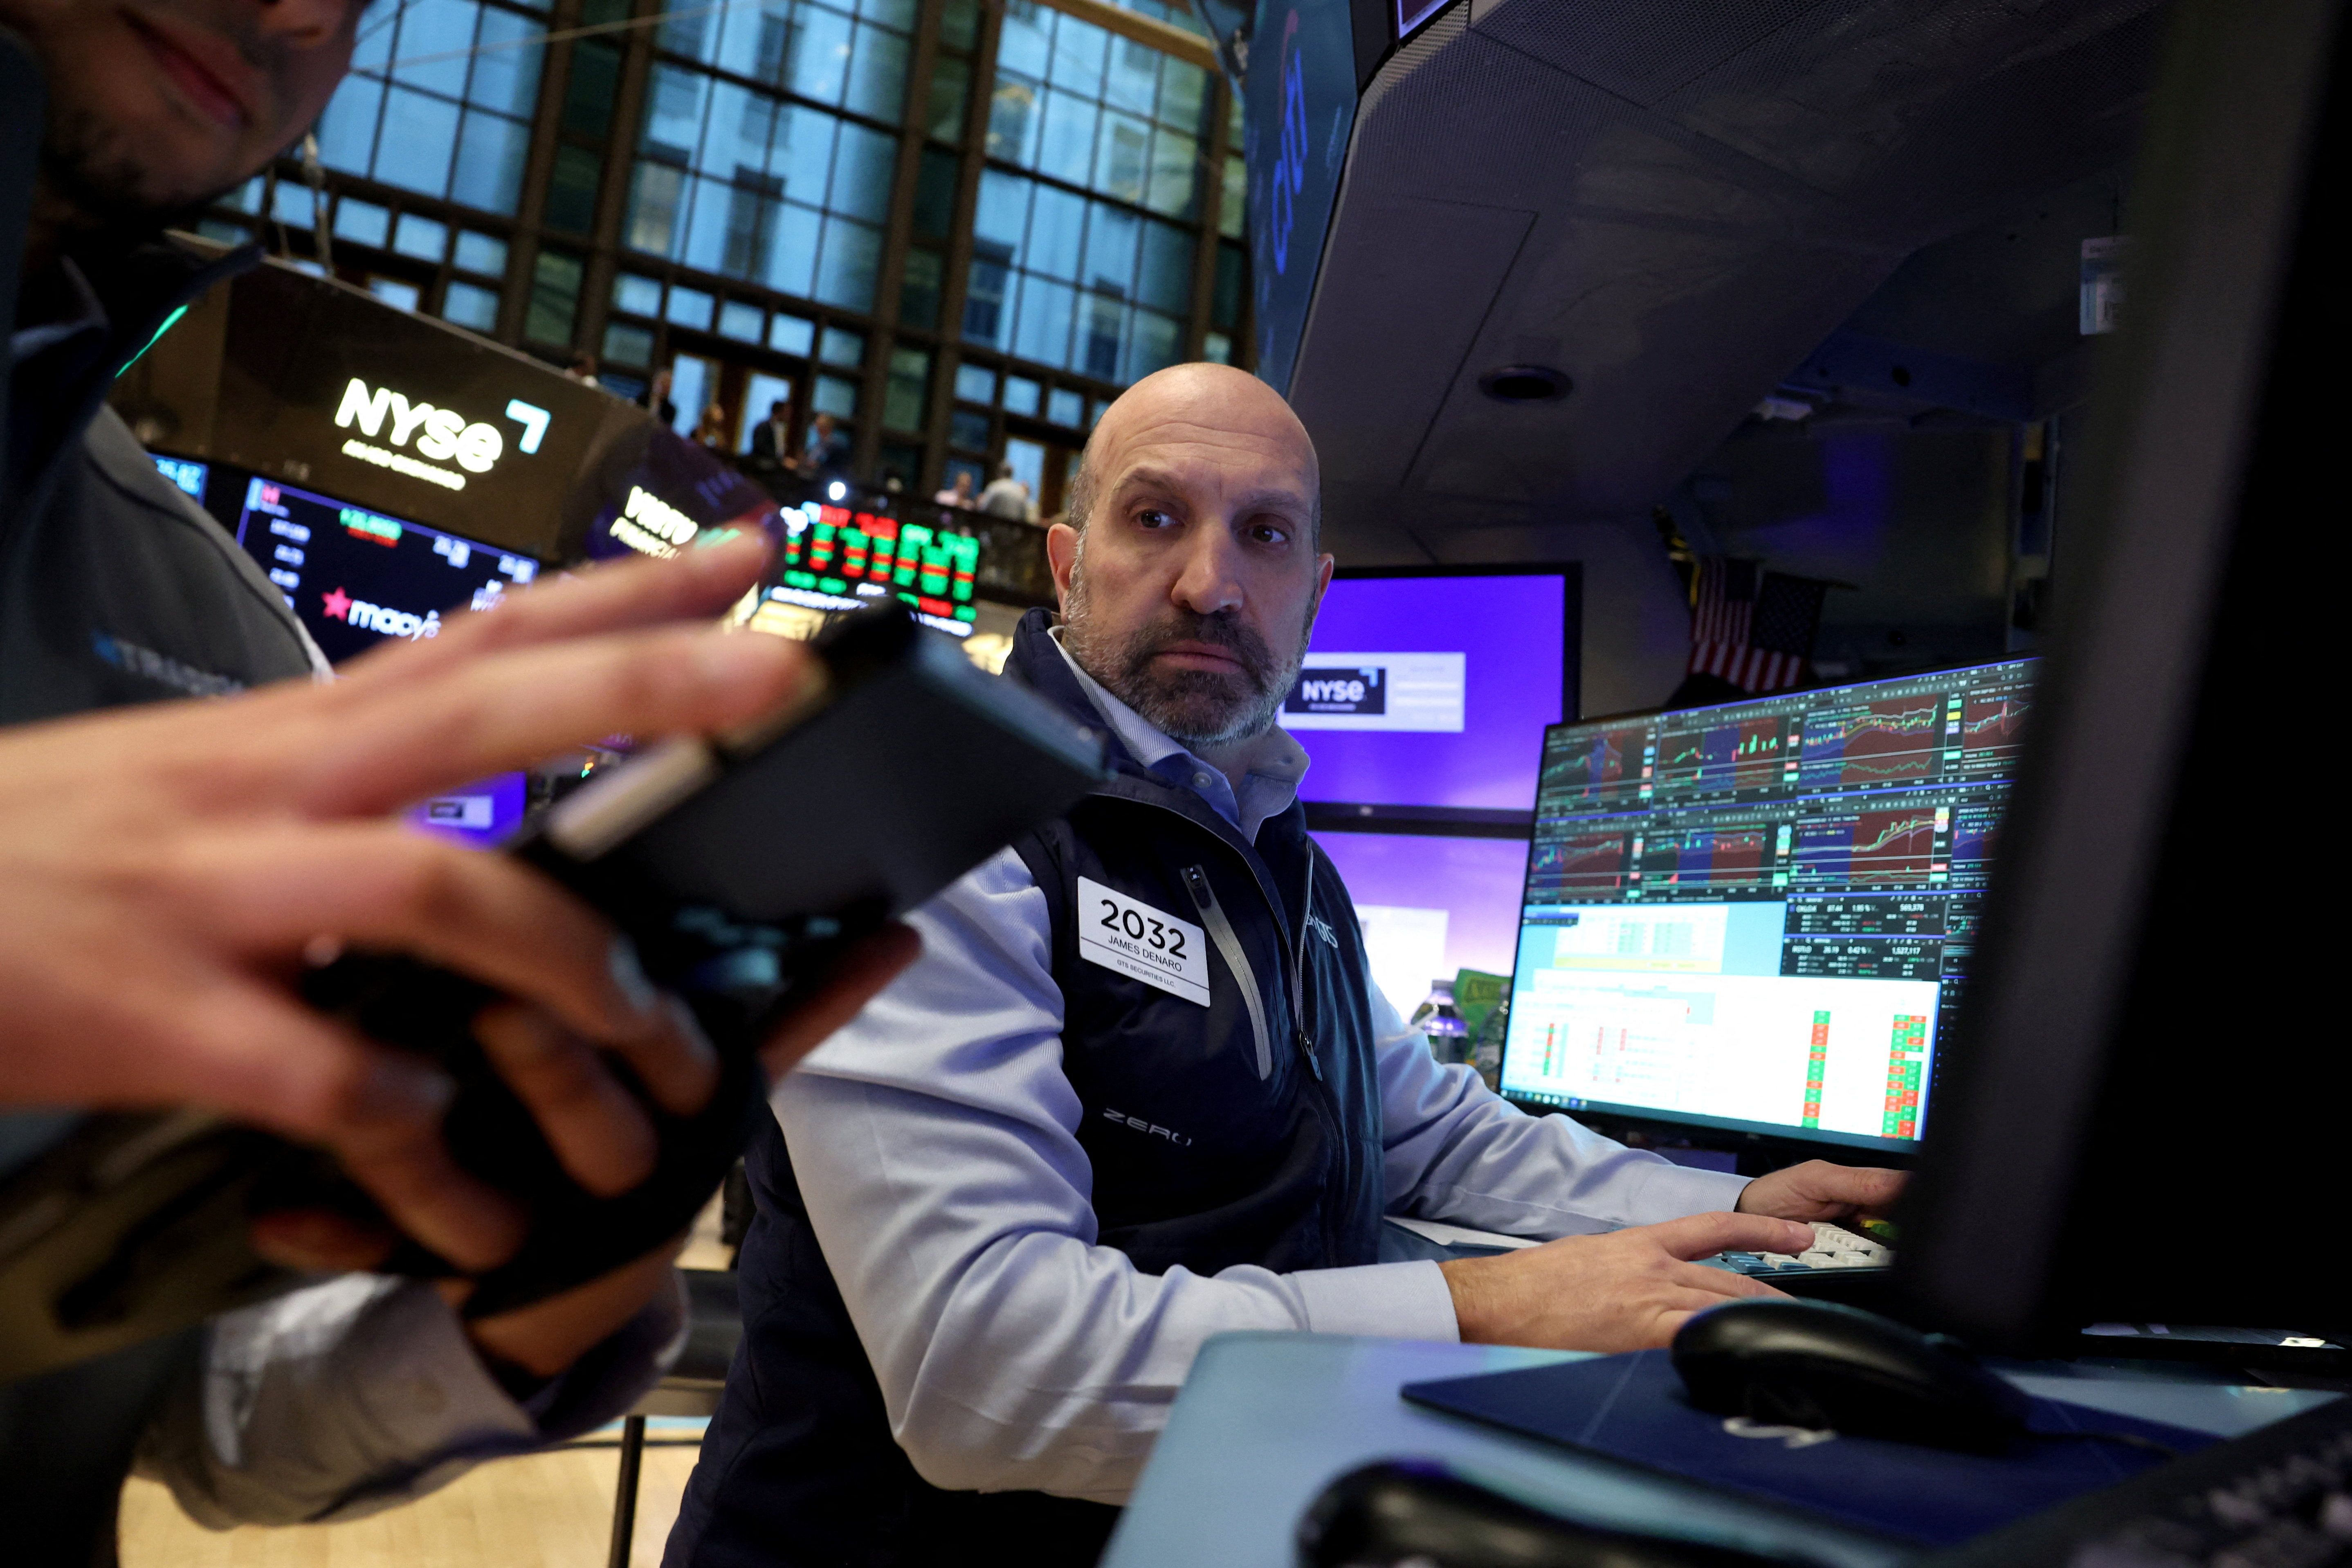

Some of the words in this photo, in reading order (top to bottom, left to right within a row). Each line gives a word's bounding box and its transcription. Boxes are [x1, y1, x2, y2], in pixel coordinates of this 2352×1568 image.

[1101, 899, 1187, 961] 2032
[1108, 935, 1140, 955] JAMES
[1143, 948, 1182, 972] DENARO
[1117, 959, 1129, 969] GTS
[1130, 964, 1163, 982] SECURITIES
